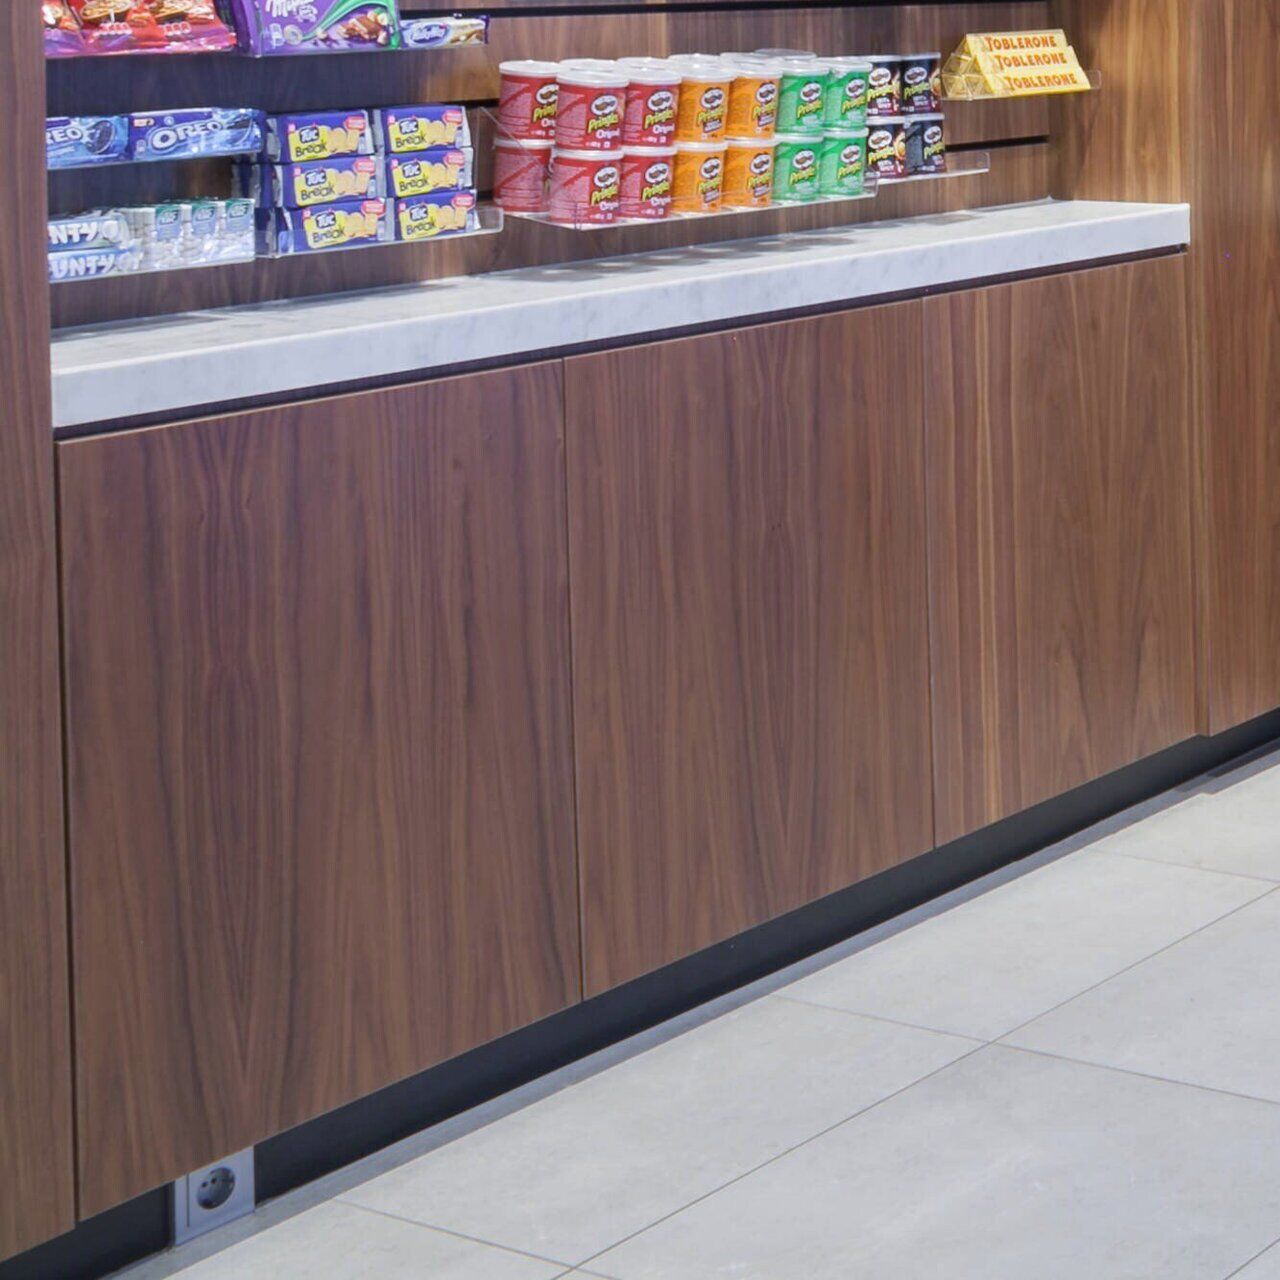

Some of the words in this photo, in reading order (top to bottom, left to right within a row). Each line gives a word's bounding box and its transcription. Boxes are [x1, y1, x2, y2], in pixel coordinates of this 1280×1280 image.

[984, 35, 1057, 52] TOBLERONE
[994, 53, 1067, 69] TOBLERONE
[1005, 73, 1077, 90] TOBLERONE
[46, 127, 82, 144] REO
[151, 121, 221, 150] OREO
[396, 132, 426, 148] Break
[295, 141, 327, 157] Break
[400, 176, 428, 191] Break
[301, 185, 335, 201] Break
[48, 222, 99, 244] NTY
[312, 226, 345, 243] Break
[406, 218, 436, 235] Break
[52, 255, 115, 278] UNTY
